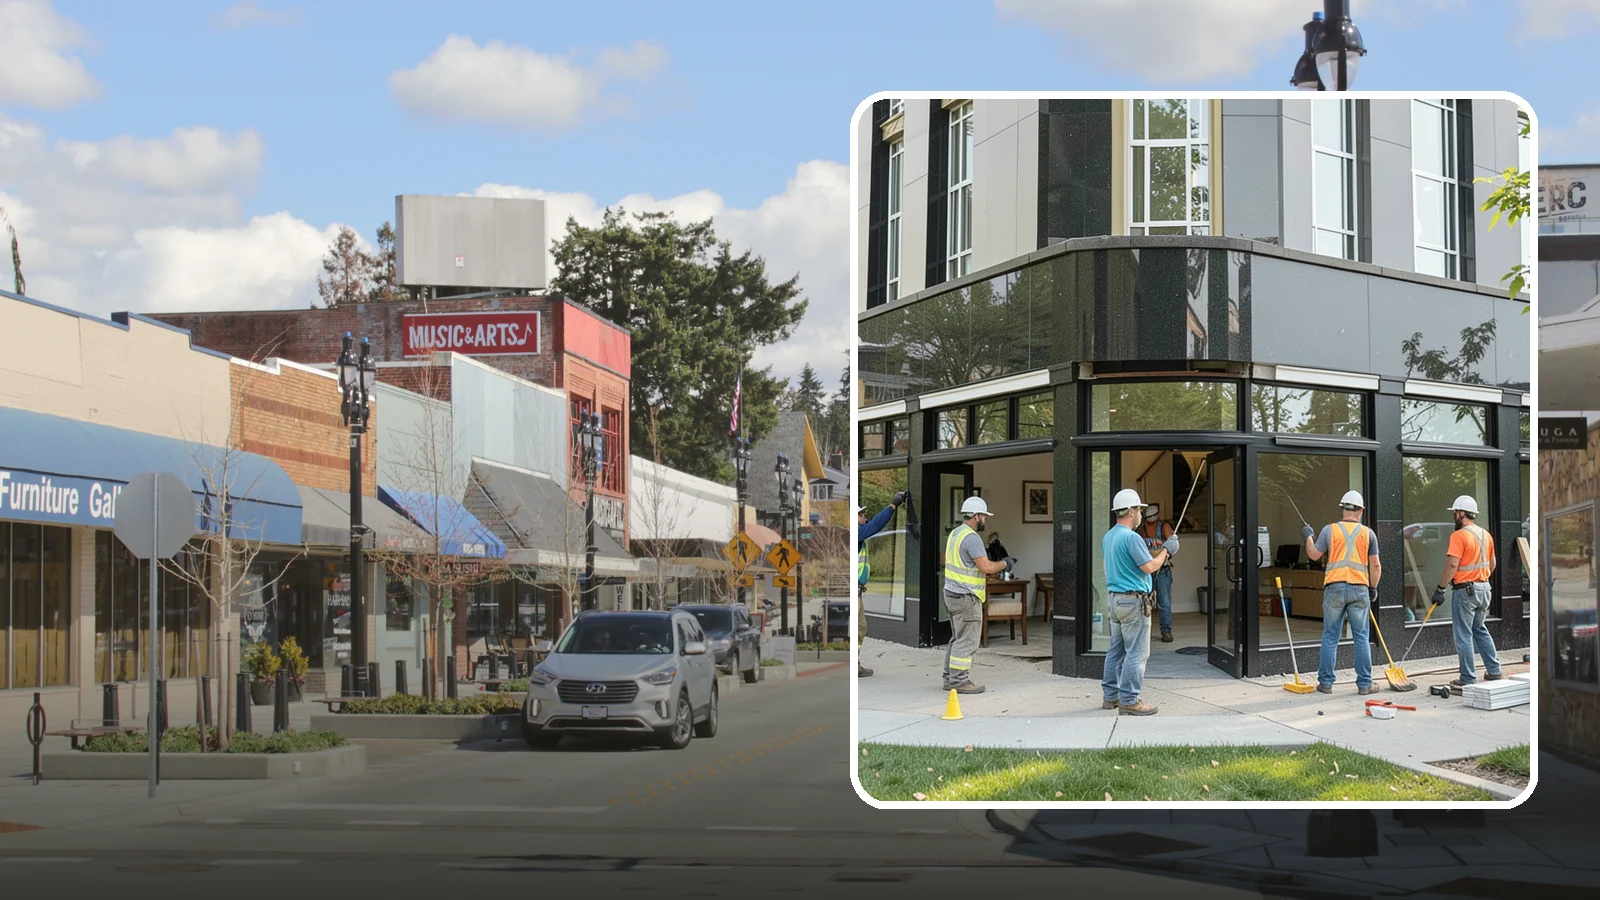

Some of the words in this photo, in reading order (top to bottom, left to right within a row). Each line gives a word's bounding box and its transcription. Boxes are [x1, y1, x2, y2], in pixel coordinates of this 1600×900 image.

[409, 323, 520, 349] MUSIC&ARTS
[0, 471, 79, 515] Furniture
[453, 563, 479, 574] SUSHI
